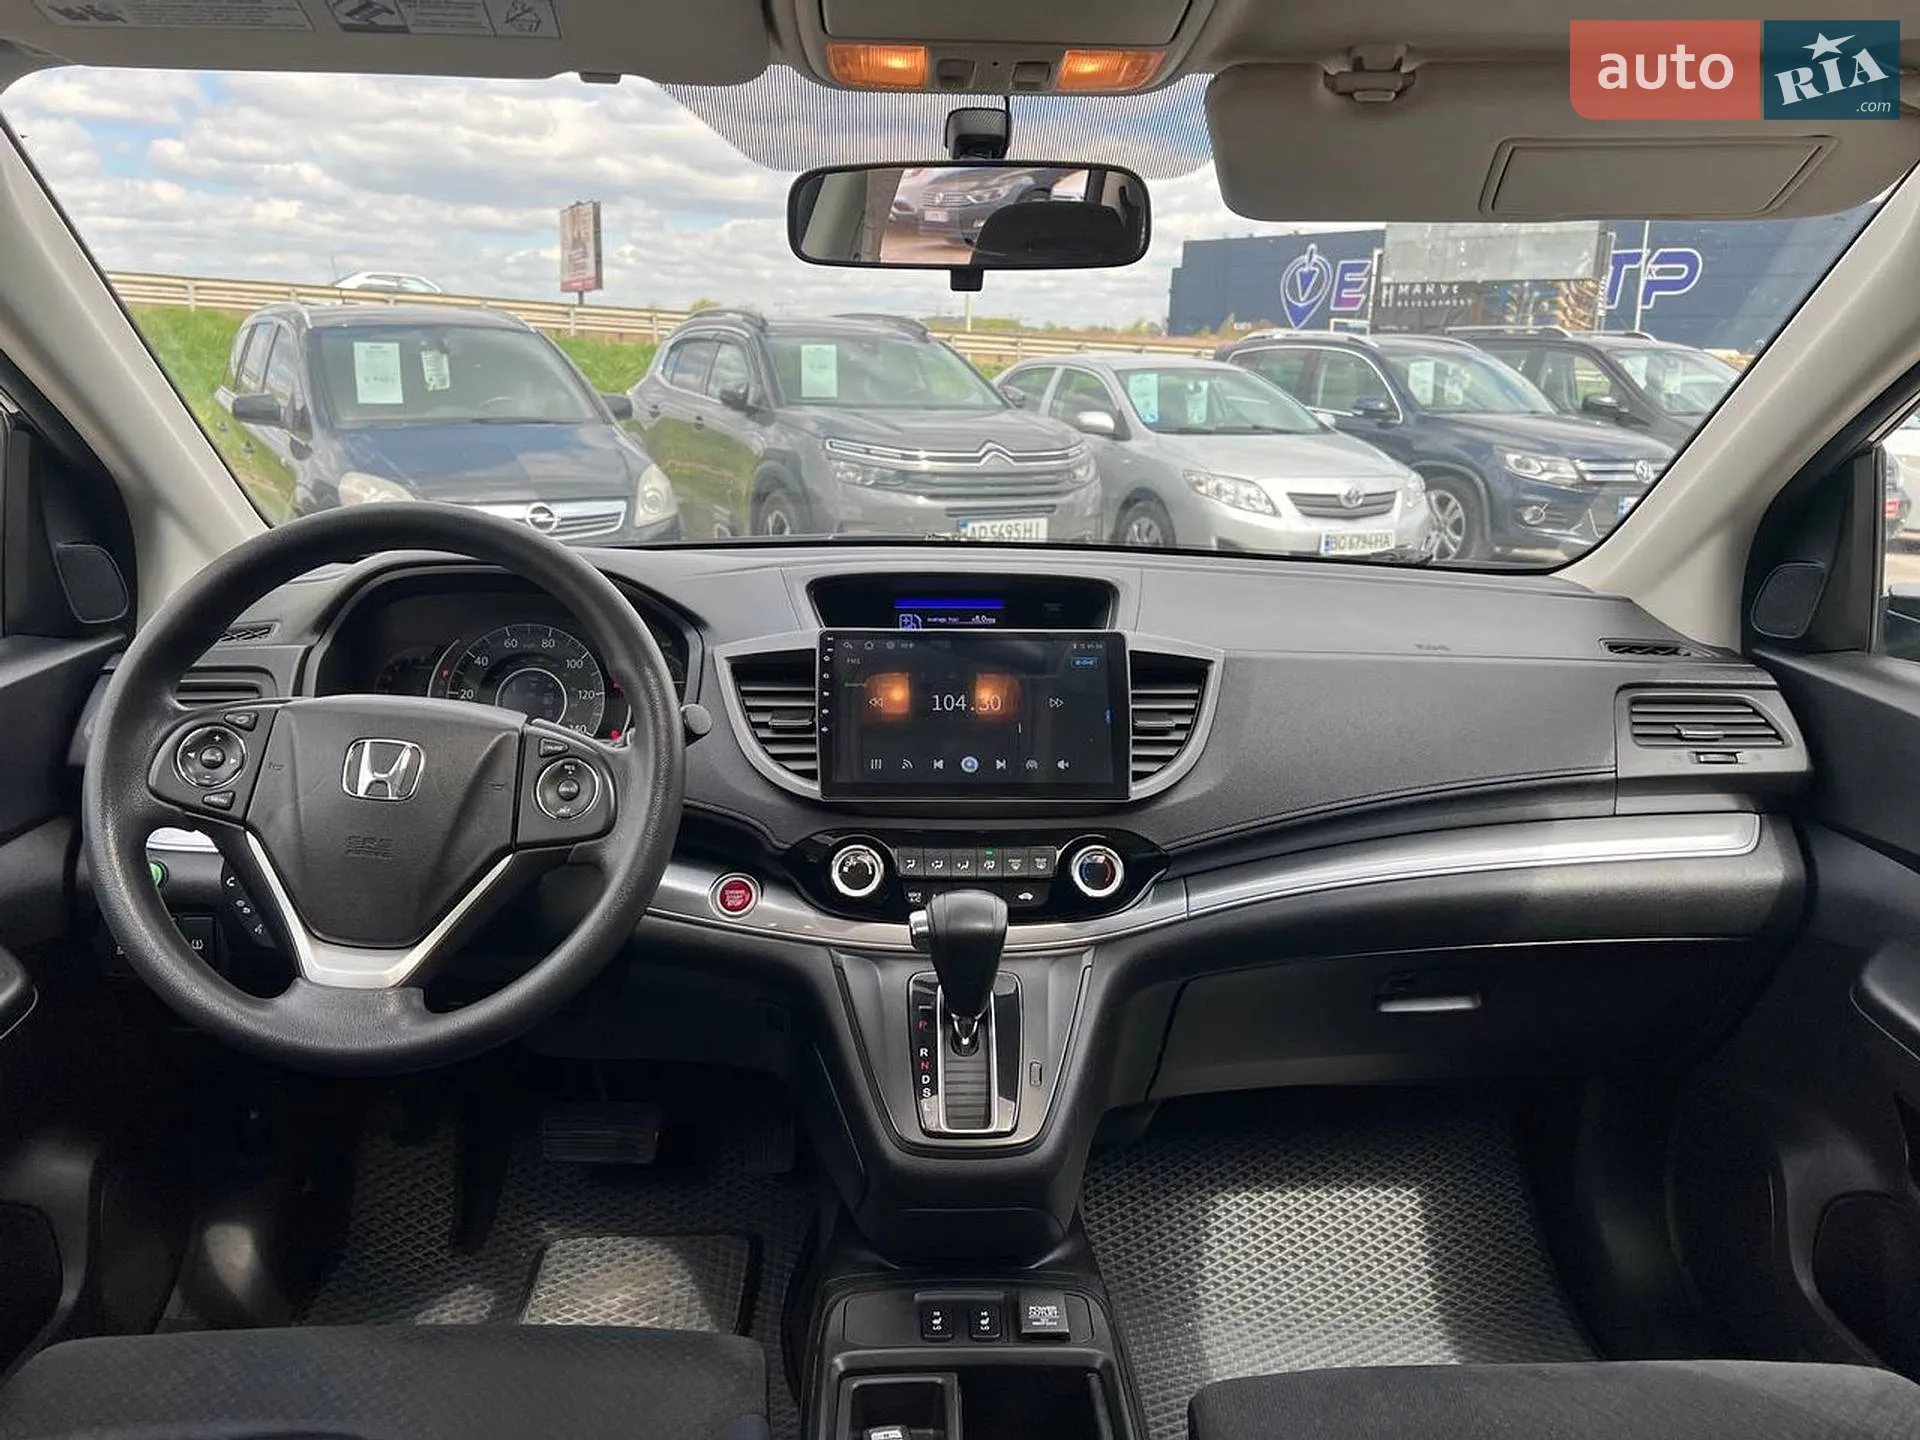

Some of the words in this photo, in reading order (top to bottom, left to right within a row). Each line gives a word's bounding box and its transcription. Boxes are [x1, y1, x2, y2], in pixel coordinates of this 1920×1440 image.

[503, 638, 518, 649] 60
[541, 638, 556, 649] 80
[474, 655, 489, 667] 40
[566, 658, 584, 669] 100
[460, 687, 474, 699] 20
[578, 689, 596, 700] 120
[932, 694, 1002, 713] 104.30
[919, 1047, 930, 1058] R
[920, 1061, 931, 1071] N
[921, 1074, 932, 1085] D
[922, 1087, 933, 1099] S
